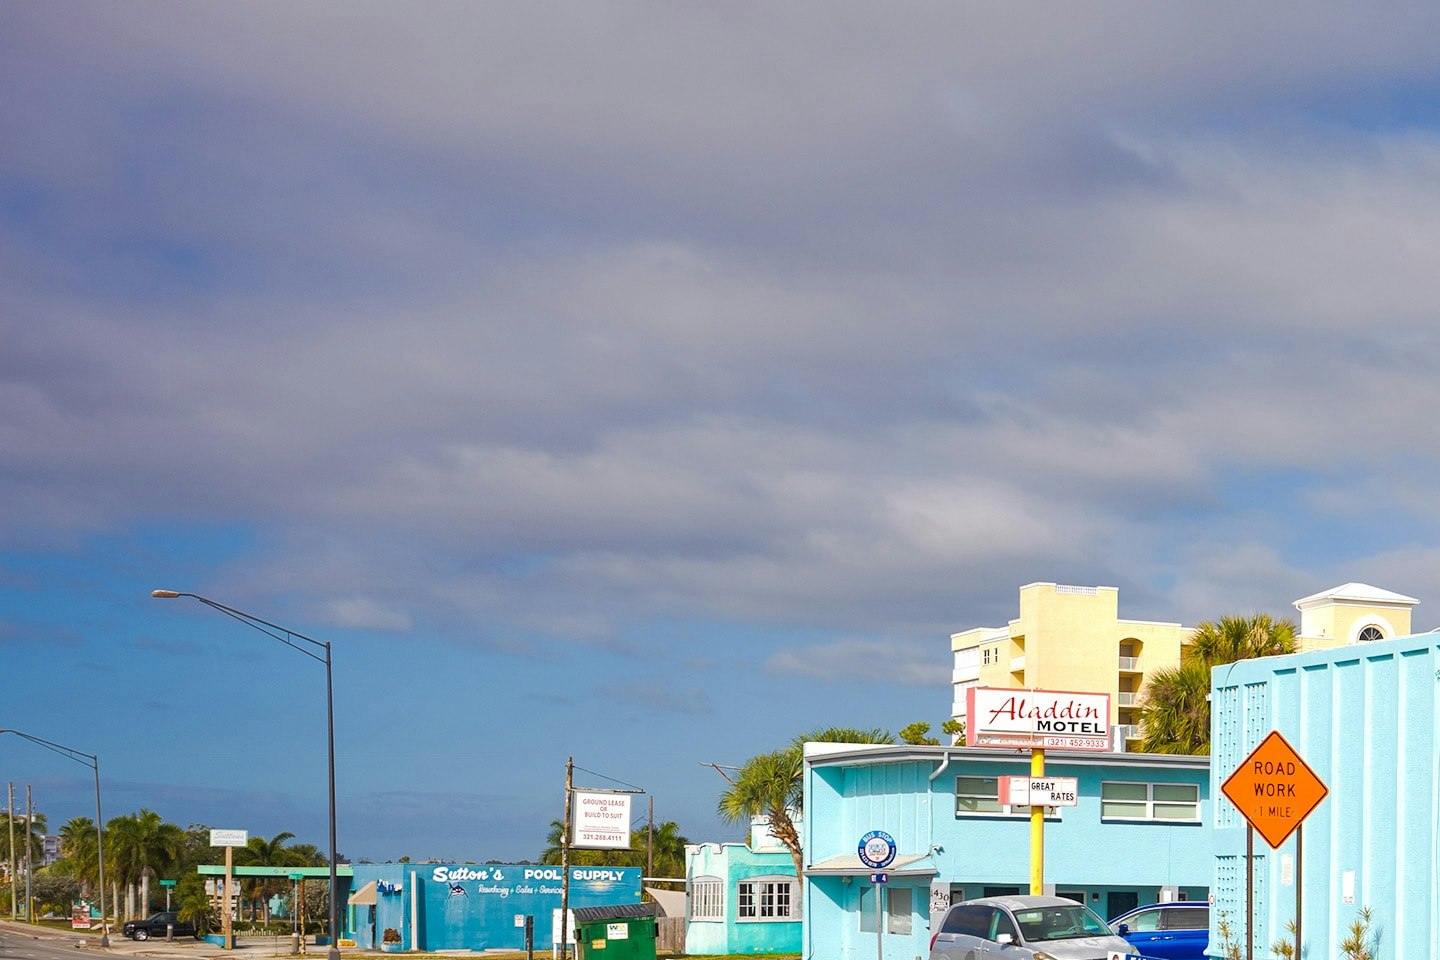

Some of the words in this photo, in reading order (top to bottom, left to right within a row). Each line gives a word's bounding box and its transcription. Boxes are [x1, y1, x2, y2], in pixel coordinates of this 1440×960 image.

[989, 696, 1099, 725] Aladdin
[1037, 720, 1106, 734] MOTEL
[1047, 738, 1067, 747] (321)
[1069, 739, 1105, 748] 452-9333
[1254, 761, 1296, 776] ROAD
[1031, 782, 1055, 791] GREAT
[1254, 783, 1296, 797] WORK
[582, 798, 607, 806] GROUND
[608, 799, 625, 807] LEASE
[1050, 792, 1075, 801] RATES
[1260, 806, 1263, 817] 1
[1268, 806, 1291, 818] MILE
[862, 832, 875, 842] BUS
[878, 831, 893, 843] STOP
[432, 867, 505, 883] Sutton's
[524, 868, 562, 880] POOL
[573, 869, 625, 881] SUPPLY
[933, 889, 950, 902] 430
